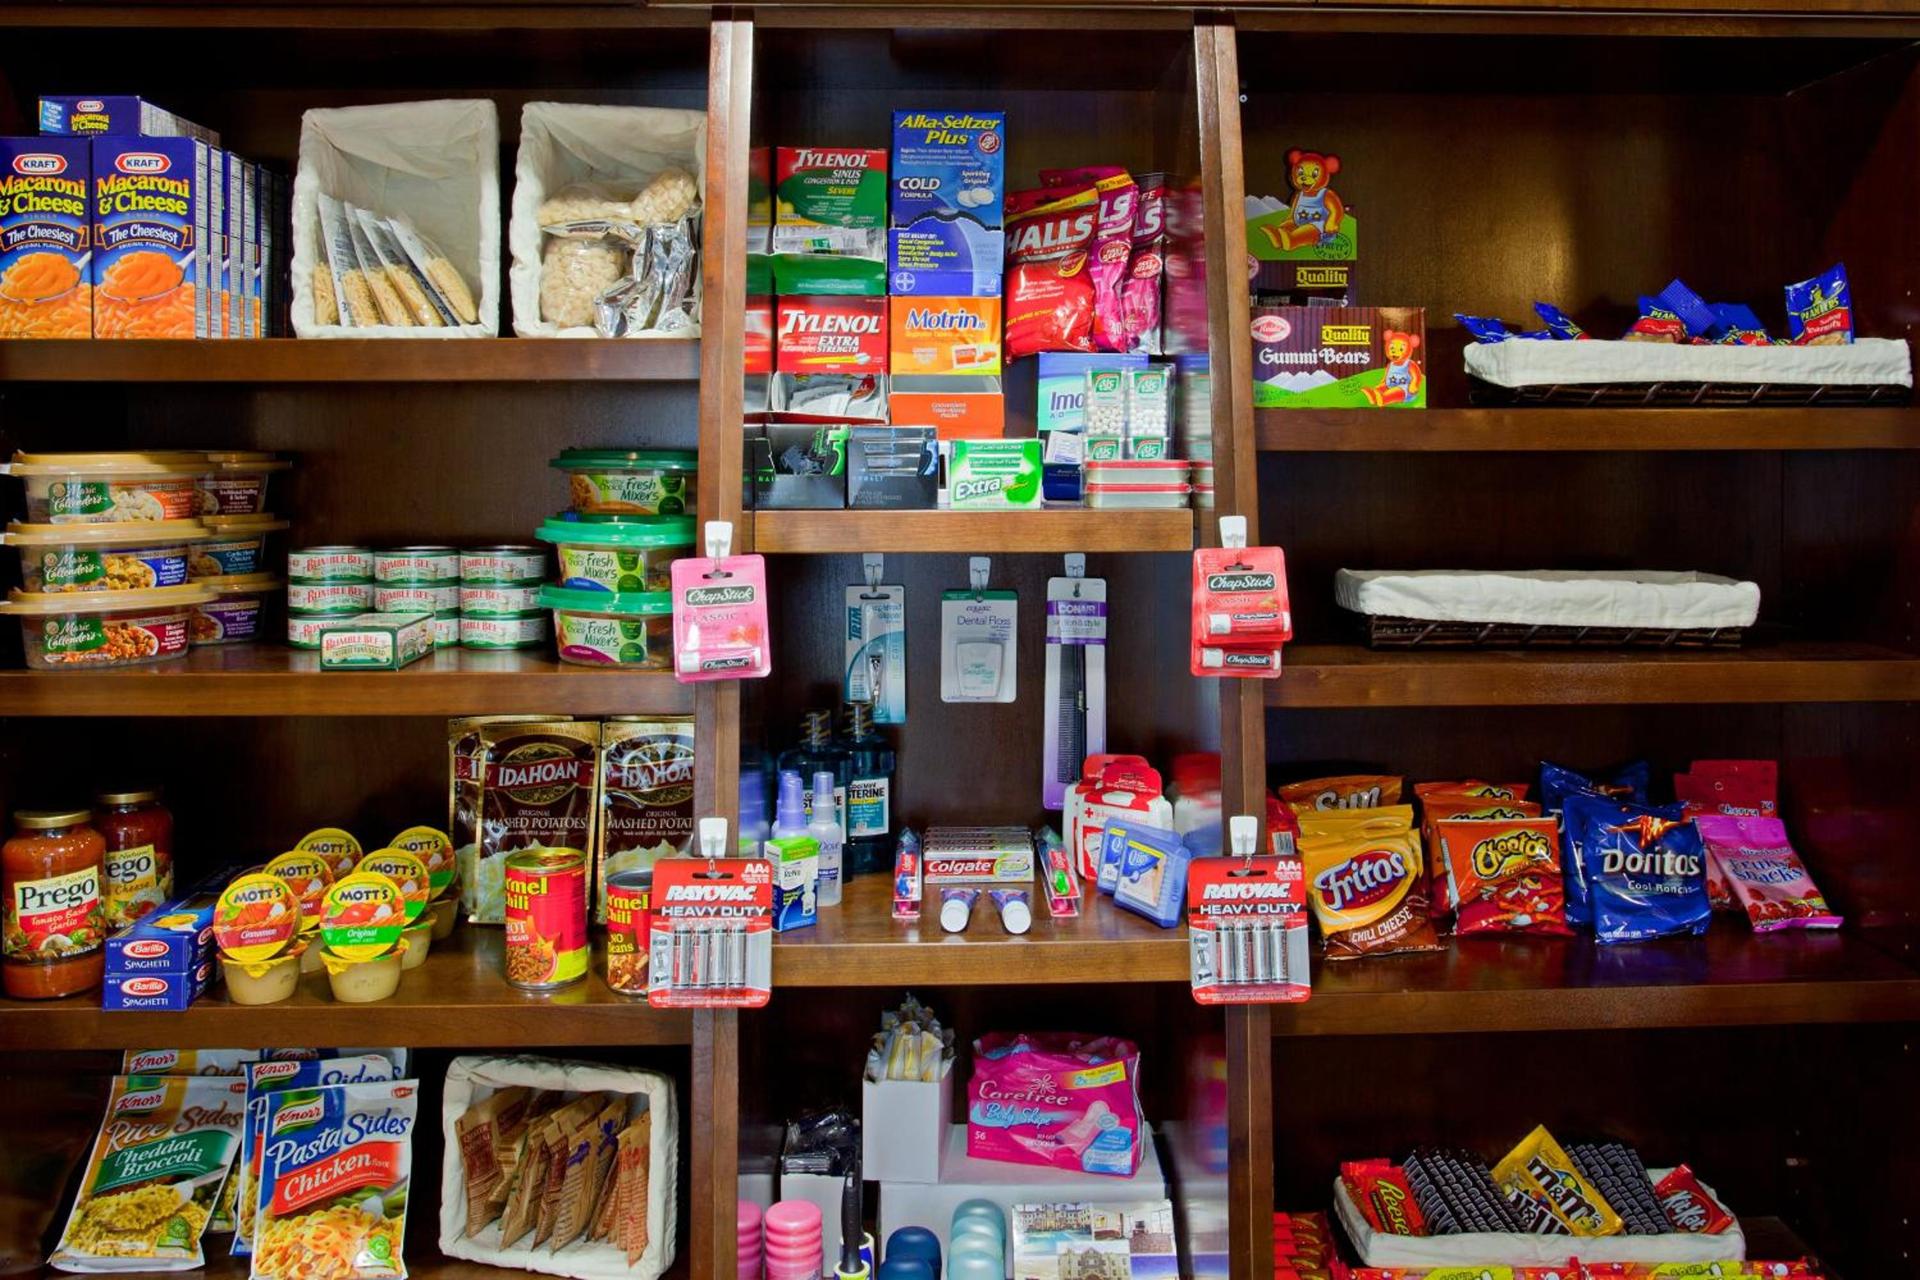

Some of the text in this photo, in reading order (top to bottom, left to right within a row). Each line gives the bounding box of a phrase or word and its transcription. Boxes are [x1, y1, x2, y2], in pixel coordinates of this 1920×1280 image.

[71, 113, 110, 124] Macaroni
[79, 121, 110, 131] Cheese
[900, 114, 1001, 129] Alka-Seltzer
[925, 130, 969, 145] Plus
[23, 160, 57, 169] KRAFT
[126, 159, 161, 168] KRAFT
[792, 150, 869, 171] TYLENOL
[832, 169, 862, 179] SINUS
[0, 174, 87, 199] Macaroni
[96, 173, 190, 199] Macaroni
[899, 178, 941, 190] COLD
[10, 191, 84, 216] Cheese
[99, 190, 187, 216] & Cheese
[7, 224, 74, 245] The Cheesiest
[109, 223, 178, 245] The Cheesiest
[1297, 268, 1349, 286] Quality
[1649, 309, 1681, 321] PLAN
[1800, 297, 1840, 322] PLANTERS
[782, 309, 880, 334] TYLENOL
[907, 308, 980, 329] Motrin
[819, 336, 860, 347] EXTRA
[1322, 327, 1371, 343] Quality
[1259, 347, 1371, 365] Gummi Bears
[626, 477, 657, 491] Fresh
[954, 478, 1001, 500] Extra
[620, 489, 660, 501] Mixers
[586, 552, 615, 567] Fresh
[583, 566, 618, 579] Mixers
[1210, 575, 1274, 592] ChapStick
[687, 586, 754, 605] ChapStick
[59, 621, 91, 638] Marie
[587, 620, 616, 636] Fresh
[848, 606, 863, 640] TRIM
[957, 616, 1012, 626] Dental Floss
[583, 635, 619, 648] Mixers
[1226, 655, 1270, 665] ChapStick
[499, 760, 580, 787] IDAHOAN
[1316, 786, 1381, 811] Sun
[531, 816, 586, 829] POTATOES
[609, 817, 693, 829] MASHED POTAT
[308, 842, 352, 855] MOTT'S
[398, 839, 440, 852] MOTT'S
[1473, 831, 1552, 879] Cheetos
[1602, 846, 1701, 875] Doritos
[105, 855, 151, 884] ego
[274, 863, 320, 878] MOTT'S
[368, 862, 418, 876] MOTT'S
[928, 859, 993, 876] Colgate
[506, 877, 548, 896] rmel
[1313, 852, 1407, 911] Fritos
[1628, 880, 1652, 891] Cool
[19, 878, 96, 912] Prego
[234, 886, 282, 905] MOTT'S
[339, 888, 389, 903] MOTT'S
[666, 885, 758, 901] RAYOVAC
[1203, 883, 1292, 900] RAYOVAC
[607, 895, 648, 911] rmel
[661, 906, 768, 917] HEAVY DUTY
[1200, 904, 1301, 914] HEAVY DUTY
[31, 906, 88, 926] Tomato Basil
[1351, 929, 1377, 943] CHILI
[1378, 905, 1413, 936] CHEESE
[50, 918, 78, 933] Garlic
[133, 943, 164, 953] Barilla
[124, 959, 170, 970] SPAGHETTI
[133, 981, 163, 991] Barilla
[122, 997, 168, 1007] SPAGHETTI
[132, 1051, 176, 1072] Knorr
[254, 1063, 298, 1078] Knorr
[978, 1080, 1070, 1106] Carefree
[118, 1094, 162, 1111] Knorr
[275, 1106, 322, 1124] Knorr
[986, 1103, 1015, 1128] Body
[106, 1101, 244, 1157] Rice Sides
[266, 1127, 341, 1178] Pasta
[344, 1108, 411, 1146] Sides
[115, 1138, 197, 1167] Cheddar
[119, 1148, 203, 1178] Broccoli
[283, 1152, 371, 1201] Chicken
[1376, 1179, 1411, 1236] Reese
